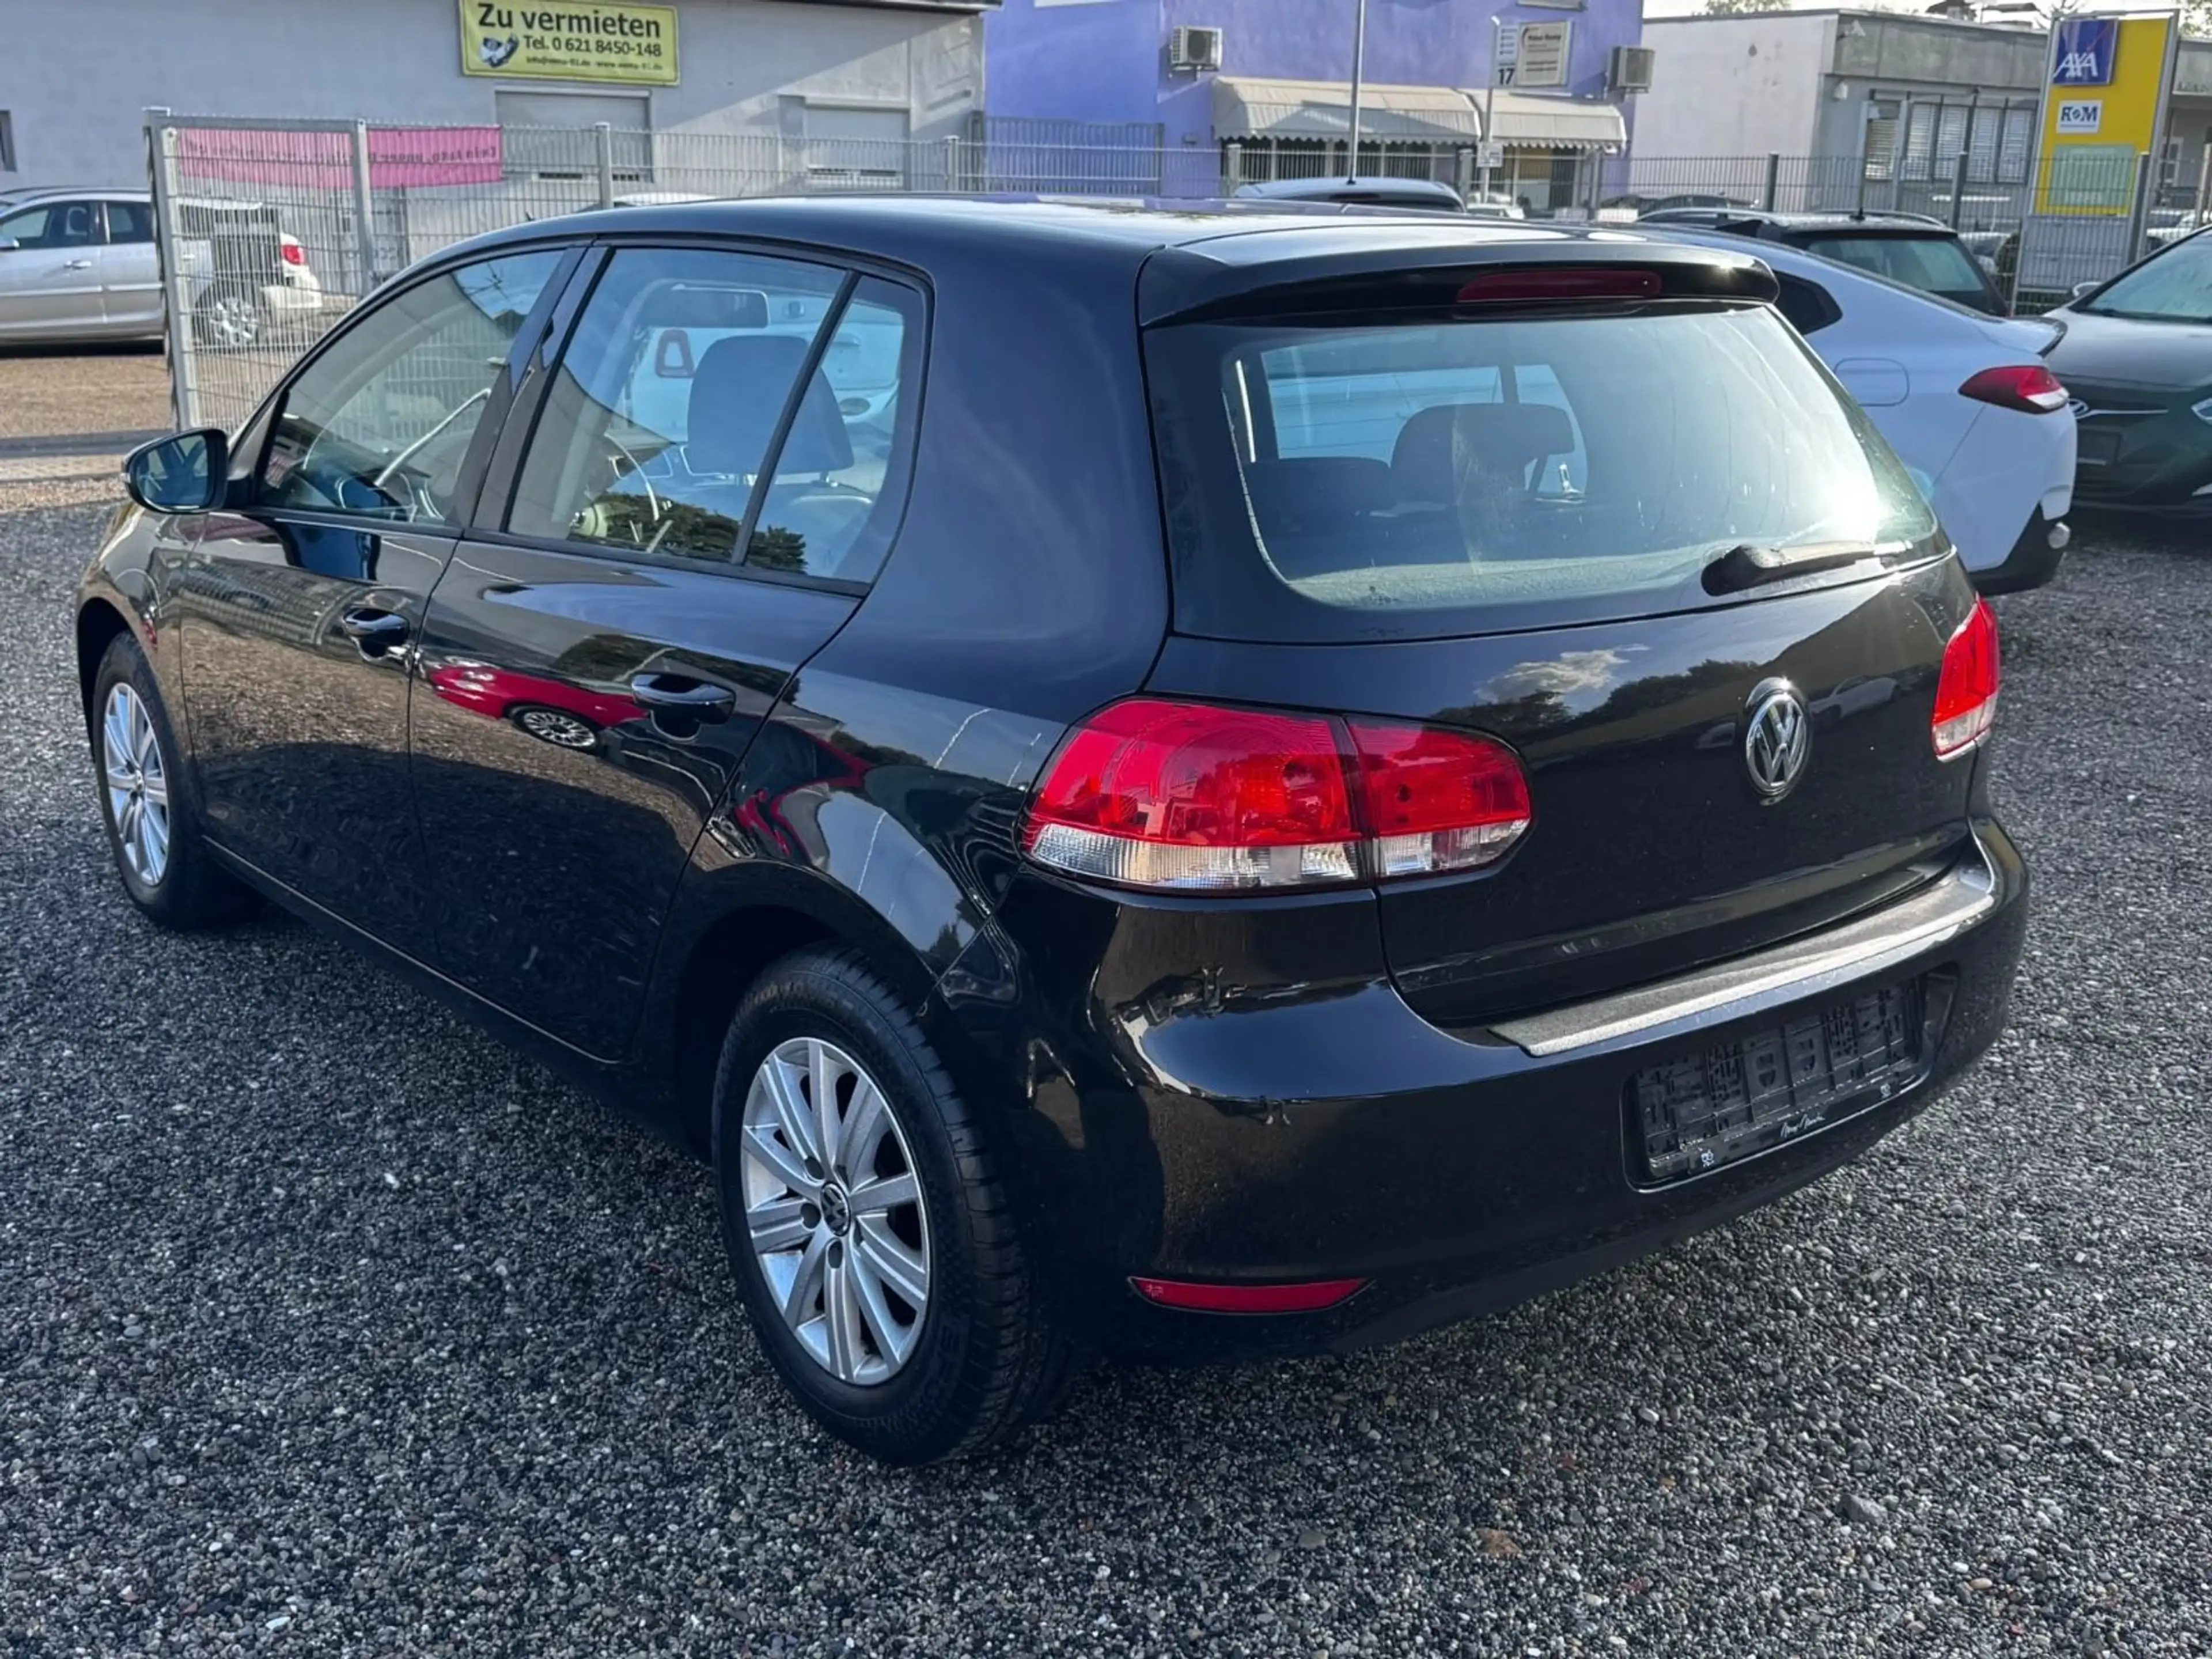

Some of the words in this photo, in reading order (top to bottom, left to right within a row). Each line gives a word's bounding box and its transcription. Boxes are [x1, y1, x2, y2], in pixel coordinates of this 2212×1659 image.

[478, 2, 513, 29] Zu
[521, 9, 661, 38] vermieten
[523, 35, 550, 50] Tel.
[552, 37, 562, 52] 0
[565, 38, 592, 54] 621
[595, 40, 662, 58] 8450-148
[1498, 68, 1516, 85] 17
[2054, 52, 2099, 78] AXA
